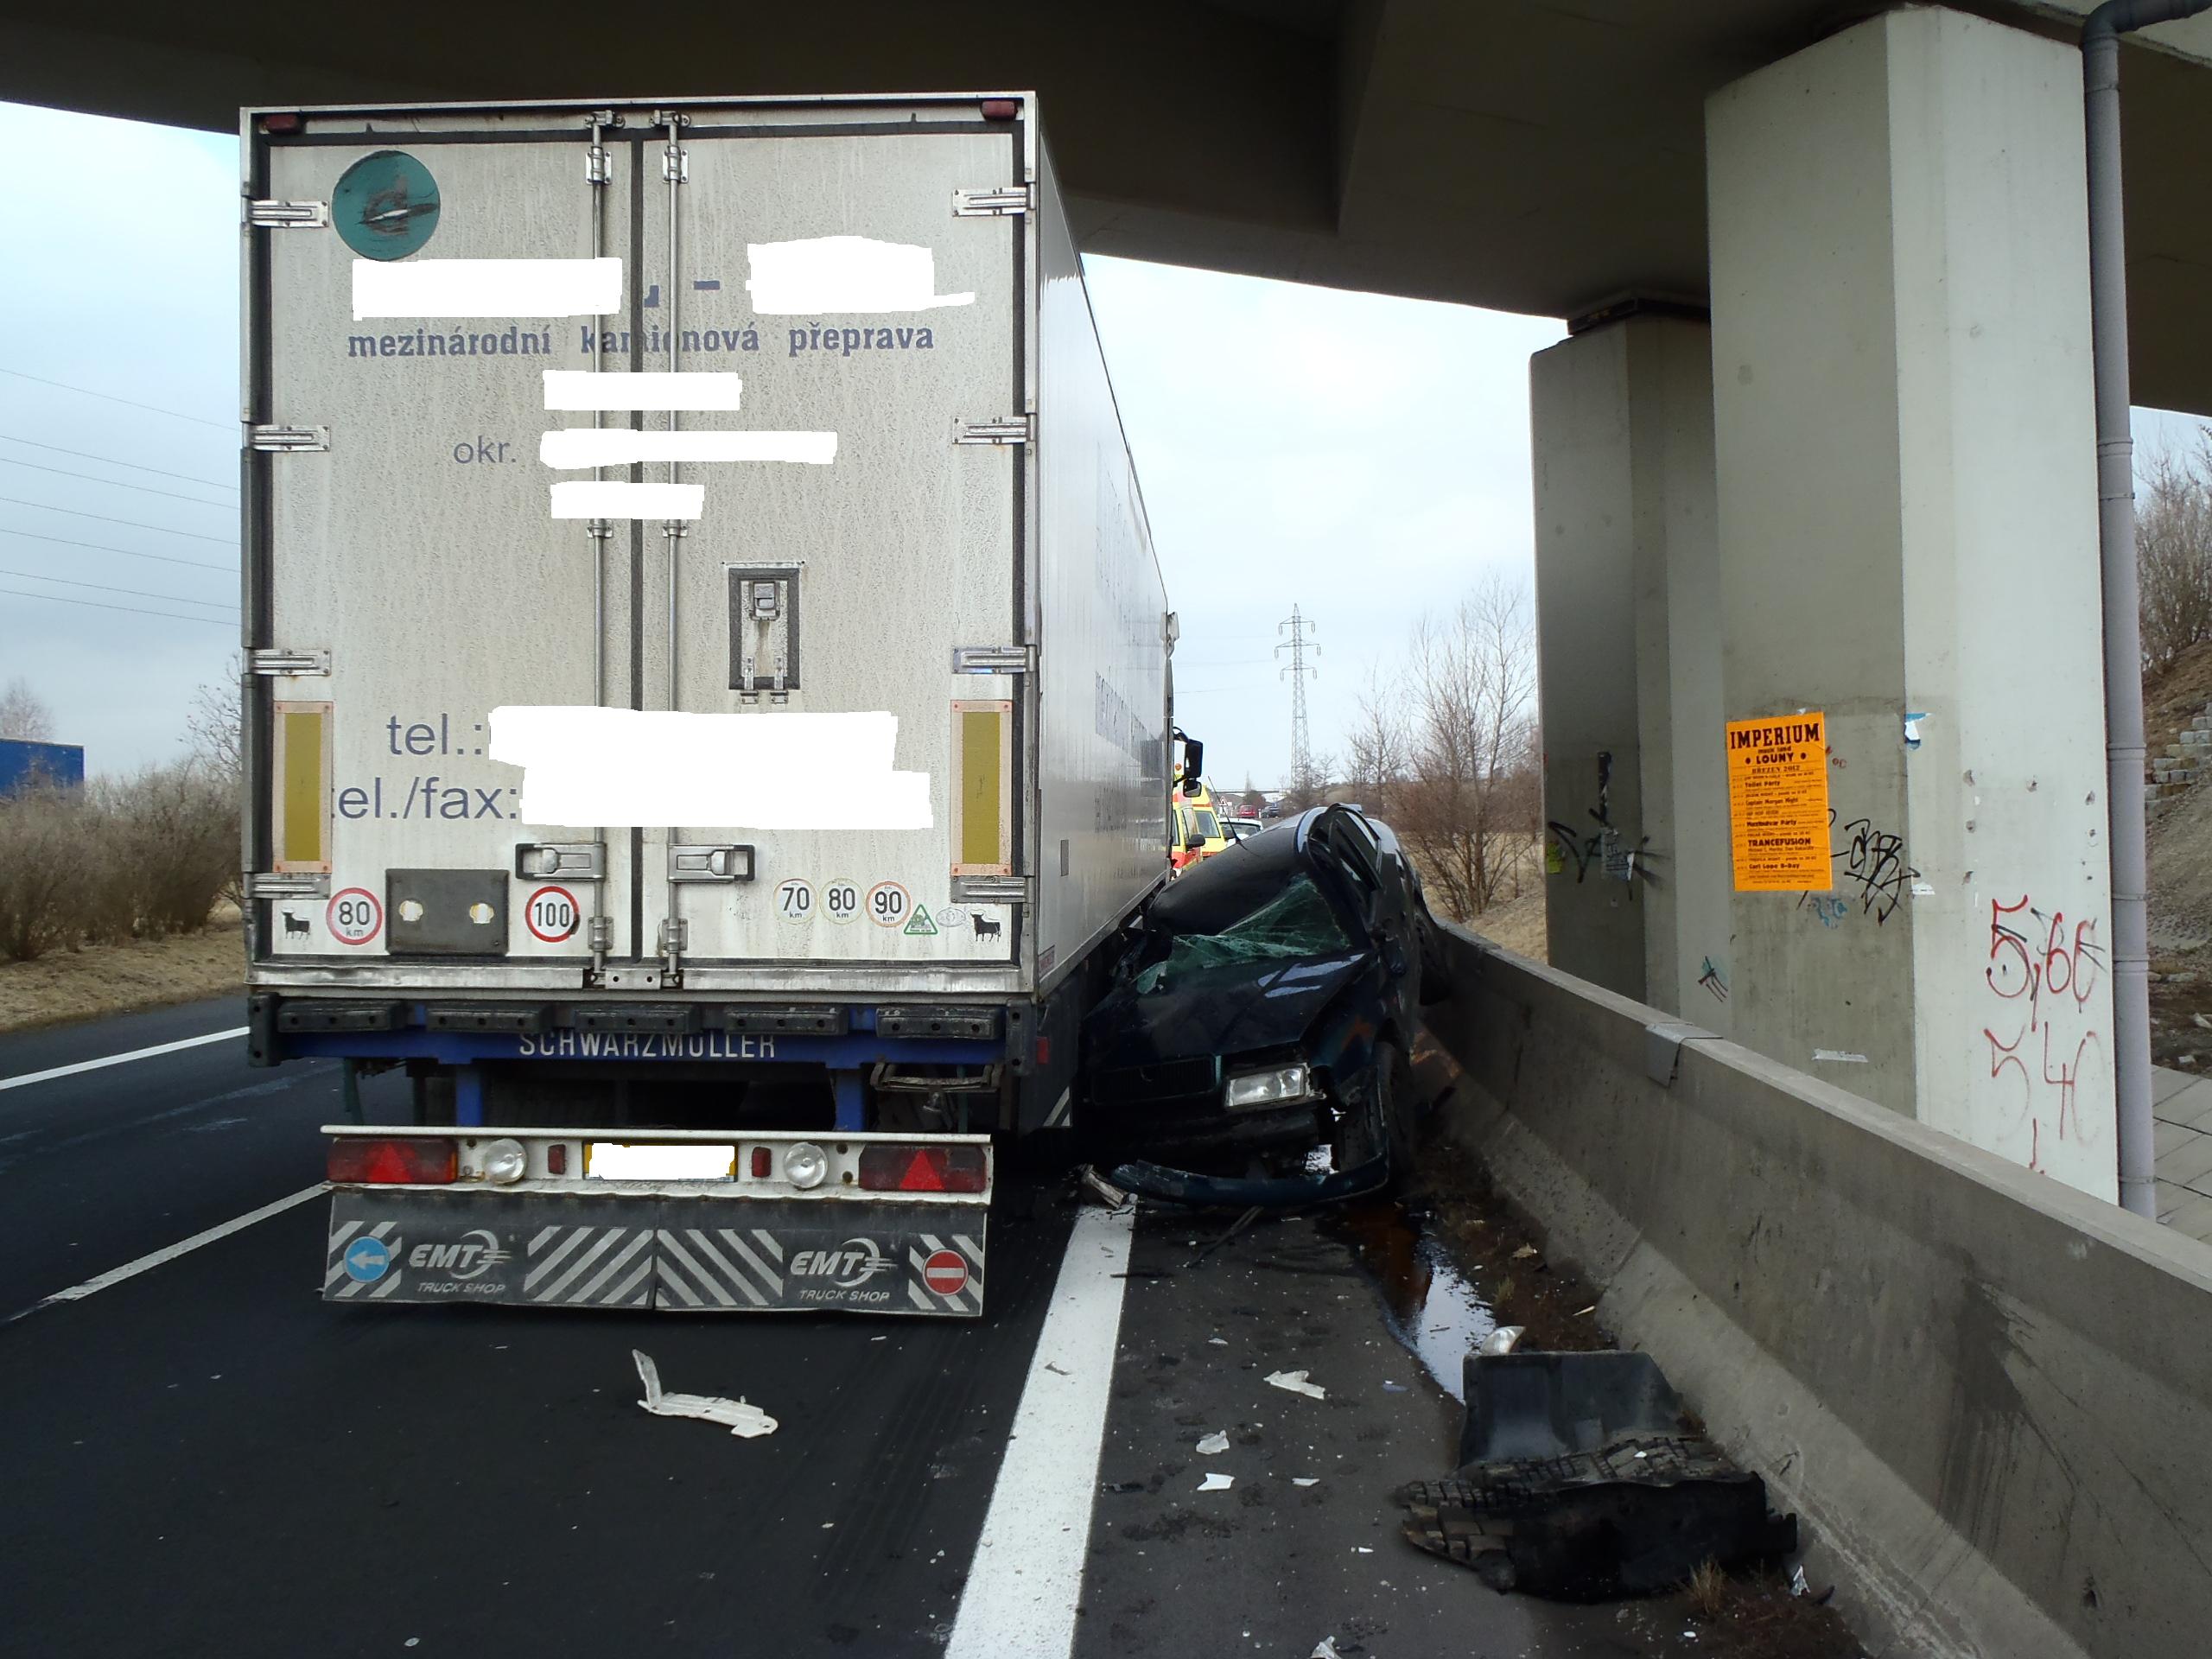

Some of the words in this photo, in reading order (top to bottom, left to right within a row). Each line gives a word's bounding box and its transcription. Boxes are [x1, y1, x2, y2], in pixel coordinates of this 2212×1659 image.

[348, 325, 551, 358] mezinárodní
[789, 321, 934, 358] přeprava
[453, 435, 517, 465] okr.
[386, 713, 482, 756] tel.:
[1730, 722, 1820, 750] IMPERIUM
[1756, 753, 1794, 765] LOUNY
[333, 776, 518, 819] el./fax:
[1748, 837, 1811, 848] TRANCEFUSION
[782, 887, 810, 912] 70
[828, 887, 855, 912] 80
[874, 890, 902, 914] 90
[339, 900, 371, 925] 80
[535, 901, 570, 927] 100
[346, 927, 364, 937] km
[409, 1243, 484, 1268] EMT
[790, 1250, 865, 1276] EMT
[417, 1281, 463, 1294] TRUCK
[463, 1282, 505, 1294] SHOP
[799, 1289, 848, 1300] TRUCK
[849, 1290, 891, 1302] SHOP
